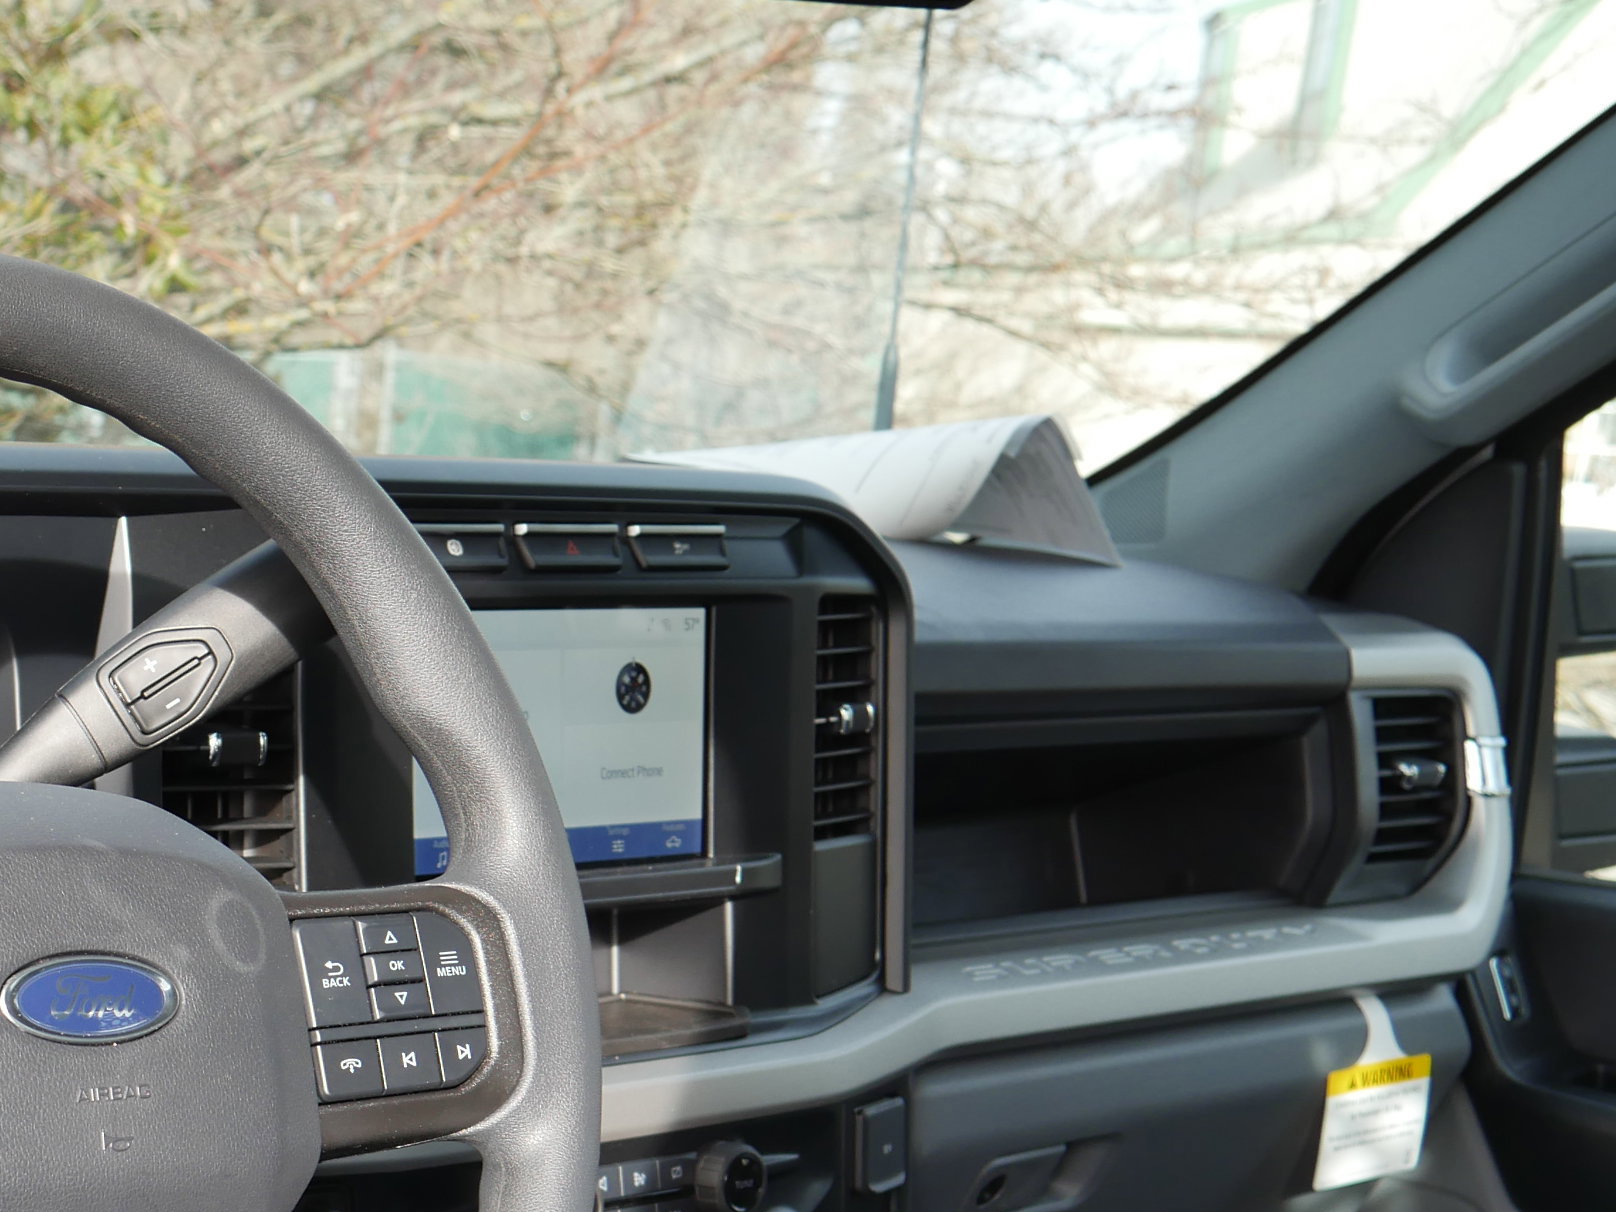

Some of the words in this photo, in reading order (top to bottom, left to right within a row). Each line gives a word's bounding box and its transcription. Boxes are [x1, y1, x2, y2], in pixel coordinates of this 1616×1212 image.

[601, 766, 634, 780] Connect
[636, 764, 663, 779] Phone
[389, 960, 406, 971] OK
[436, 965, 467, 977] MENU
[322, 976, 351, 989] BACK
[50, 973, 135, 1020] Ford
[1361, 1063, 1414, 1087] WARNING
[77, 1083, 152, 1103] AIRBAG
